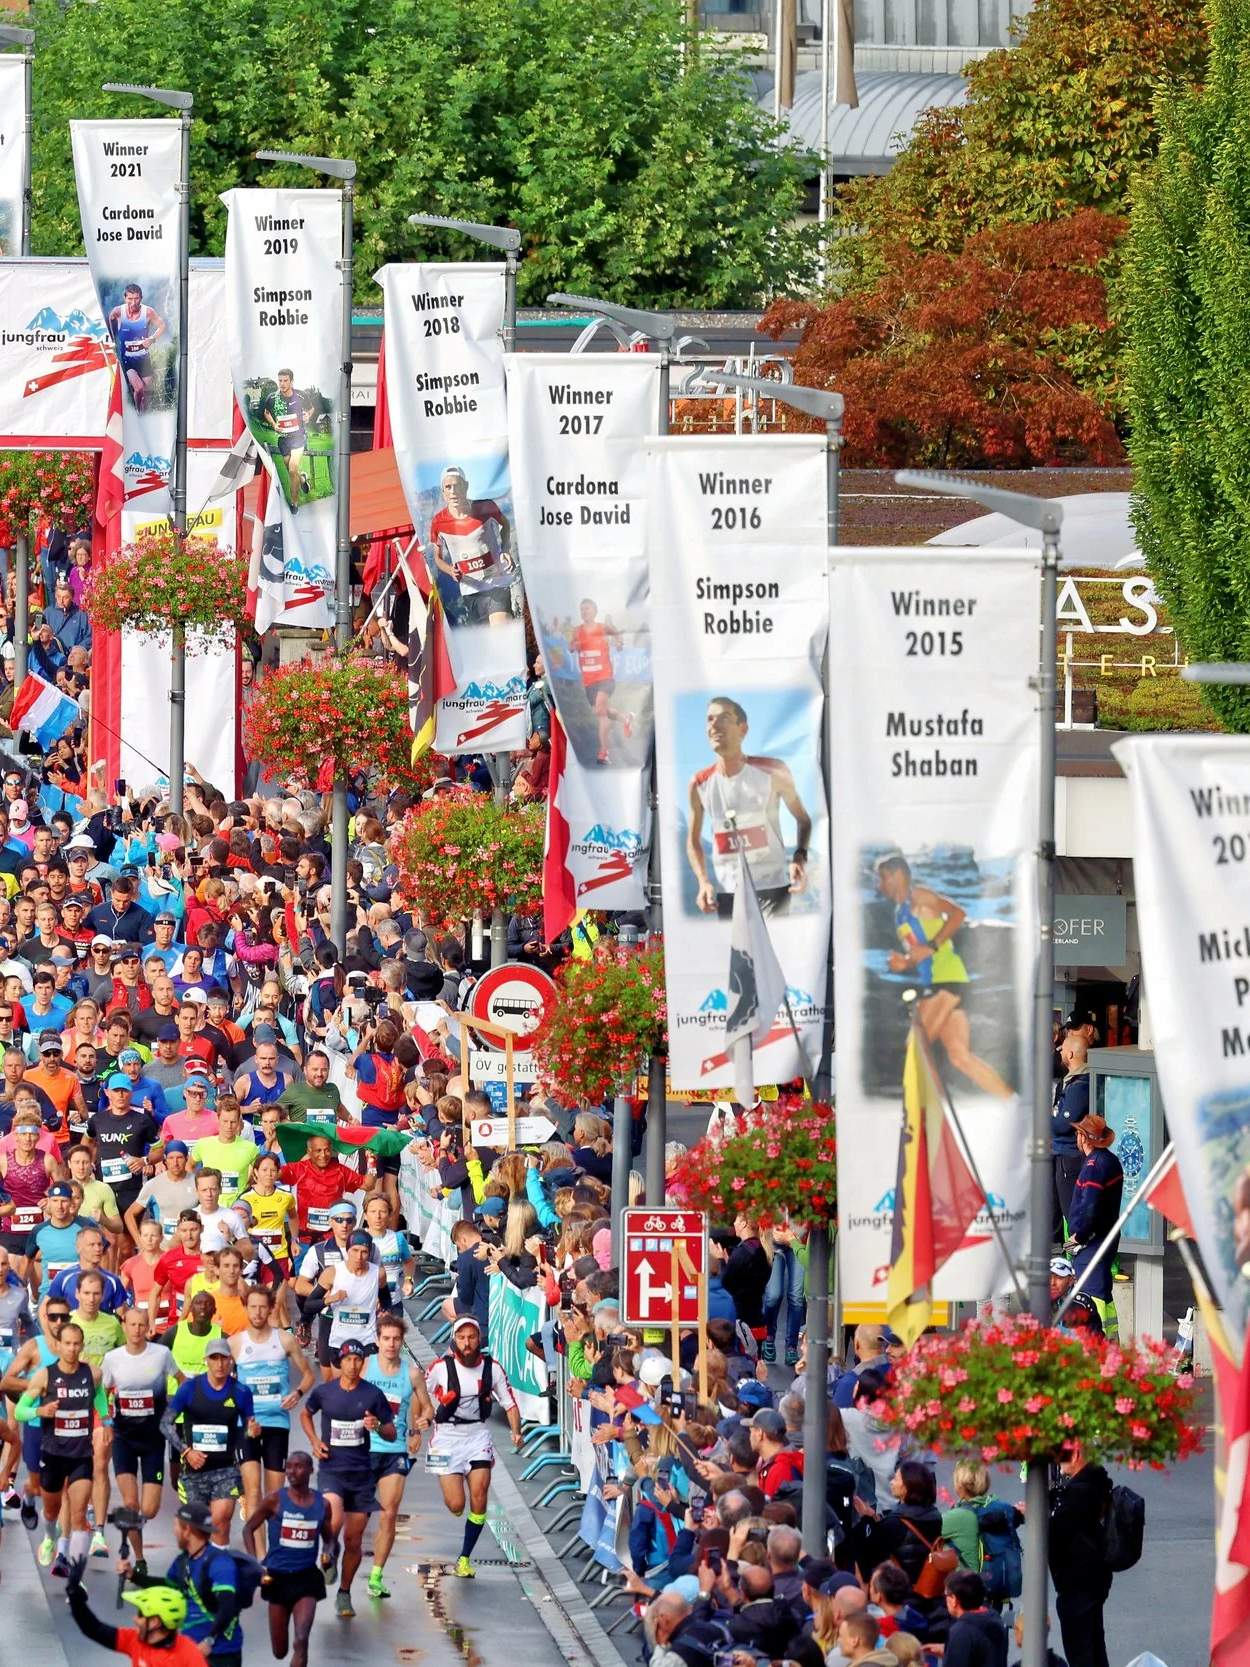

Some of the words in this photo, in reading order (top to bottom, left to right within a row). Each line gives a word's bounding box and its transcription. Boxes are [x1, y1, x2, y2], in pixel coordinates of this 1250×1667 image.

[103, 142, 148, 158] Winner
[111, 162, 143, 177] 2021
[102, 205, 154, 220] Cardona
[255, 215, 305, 232] Winner
[96, 227, 122, 243] Jose
[127, 225, 162, 241] David
[264, 239, 298, 255] 2019
[253, 286, 312, 306] Simpson
[411, 292, 464, 312] Winner
[259, 309, 309, 327] Robbie
[424, 317, 461, 337] 2018
[2, 329, 66, 345] jungfrau
[415, 370, 480, 396] Simpson
[548, 384, 613, 406] Winner
[424, 397, 478, 418] Robbie
[559, 415, 604, 435] 2017
[546, 474, 619, 496] Cardona
[698, 471, 772, 496] Winner
[540, 505, 574, 527] Jose
[580, 503, 631, 525] David
[710, 507, 762, 530] 2016
[467, 558, 486, 570] 102
[695, 577, 780, 606] Simpson
[890, 590, 978, 617] Winner
[704, 610, 774, 636] Robbie
[905, 631, 964, 657] 2015
[442, 698, 485, 710] jungfrau
[885, 708, 984, 738] Mustafa
[891, 749, 979, 778] Shaban
[476, 1057, 492, 1071] ÖV
[19, 1215, 34, 1223] 124
[68, 1388, 89, 1398] BCVS
[128, 1399, 144, 1408] 102
[64, 1419, 80, 1428] 103
[291, 1529, 308, 1539] 143
